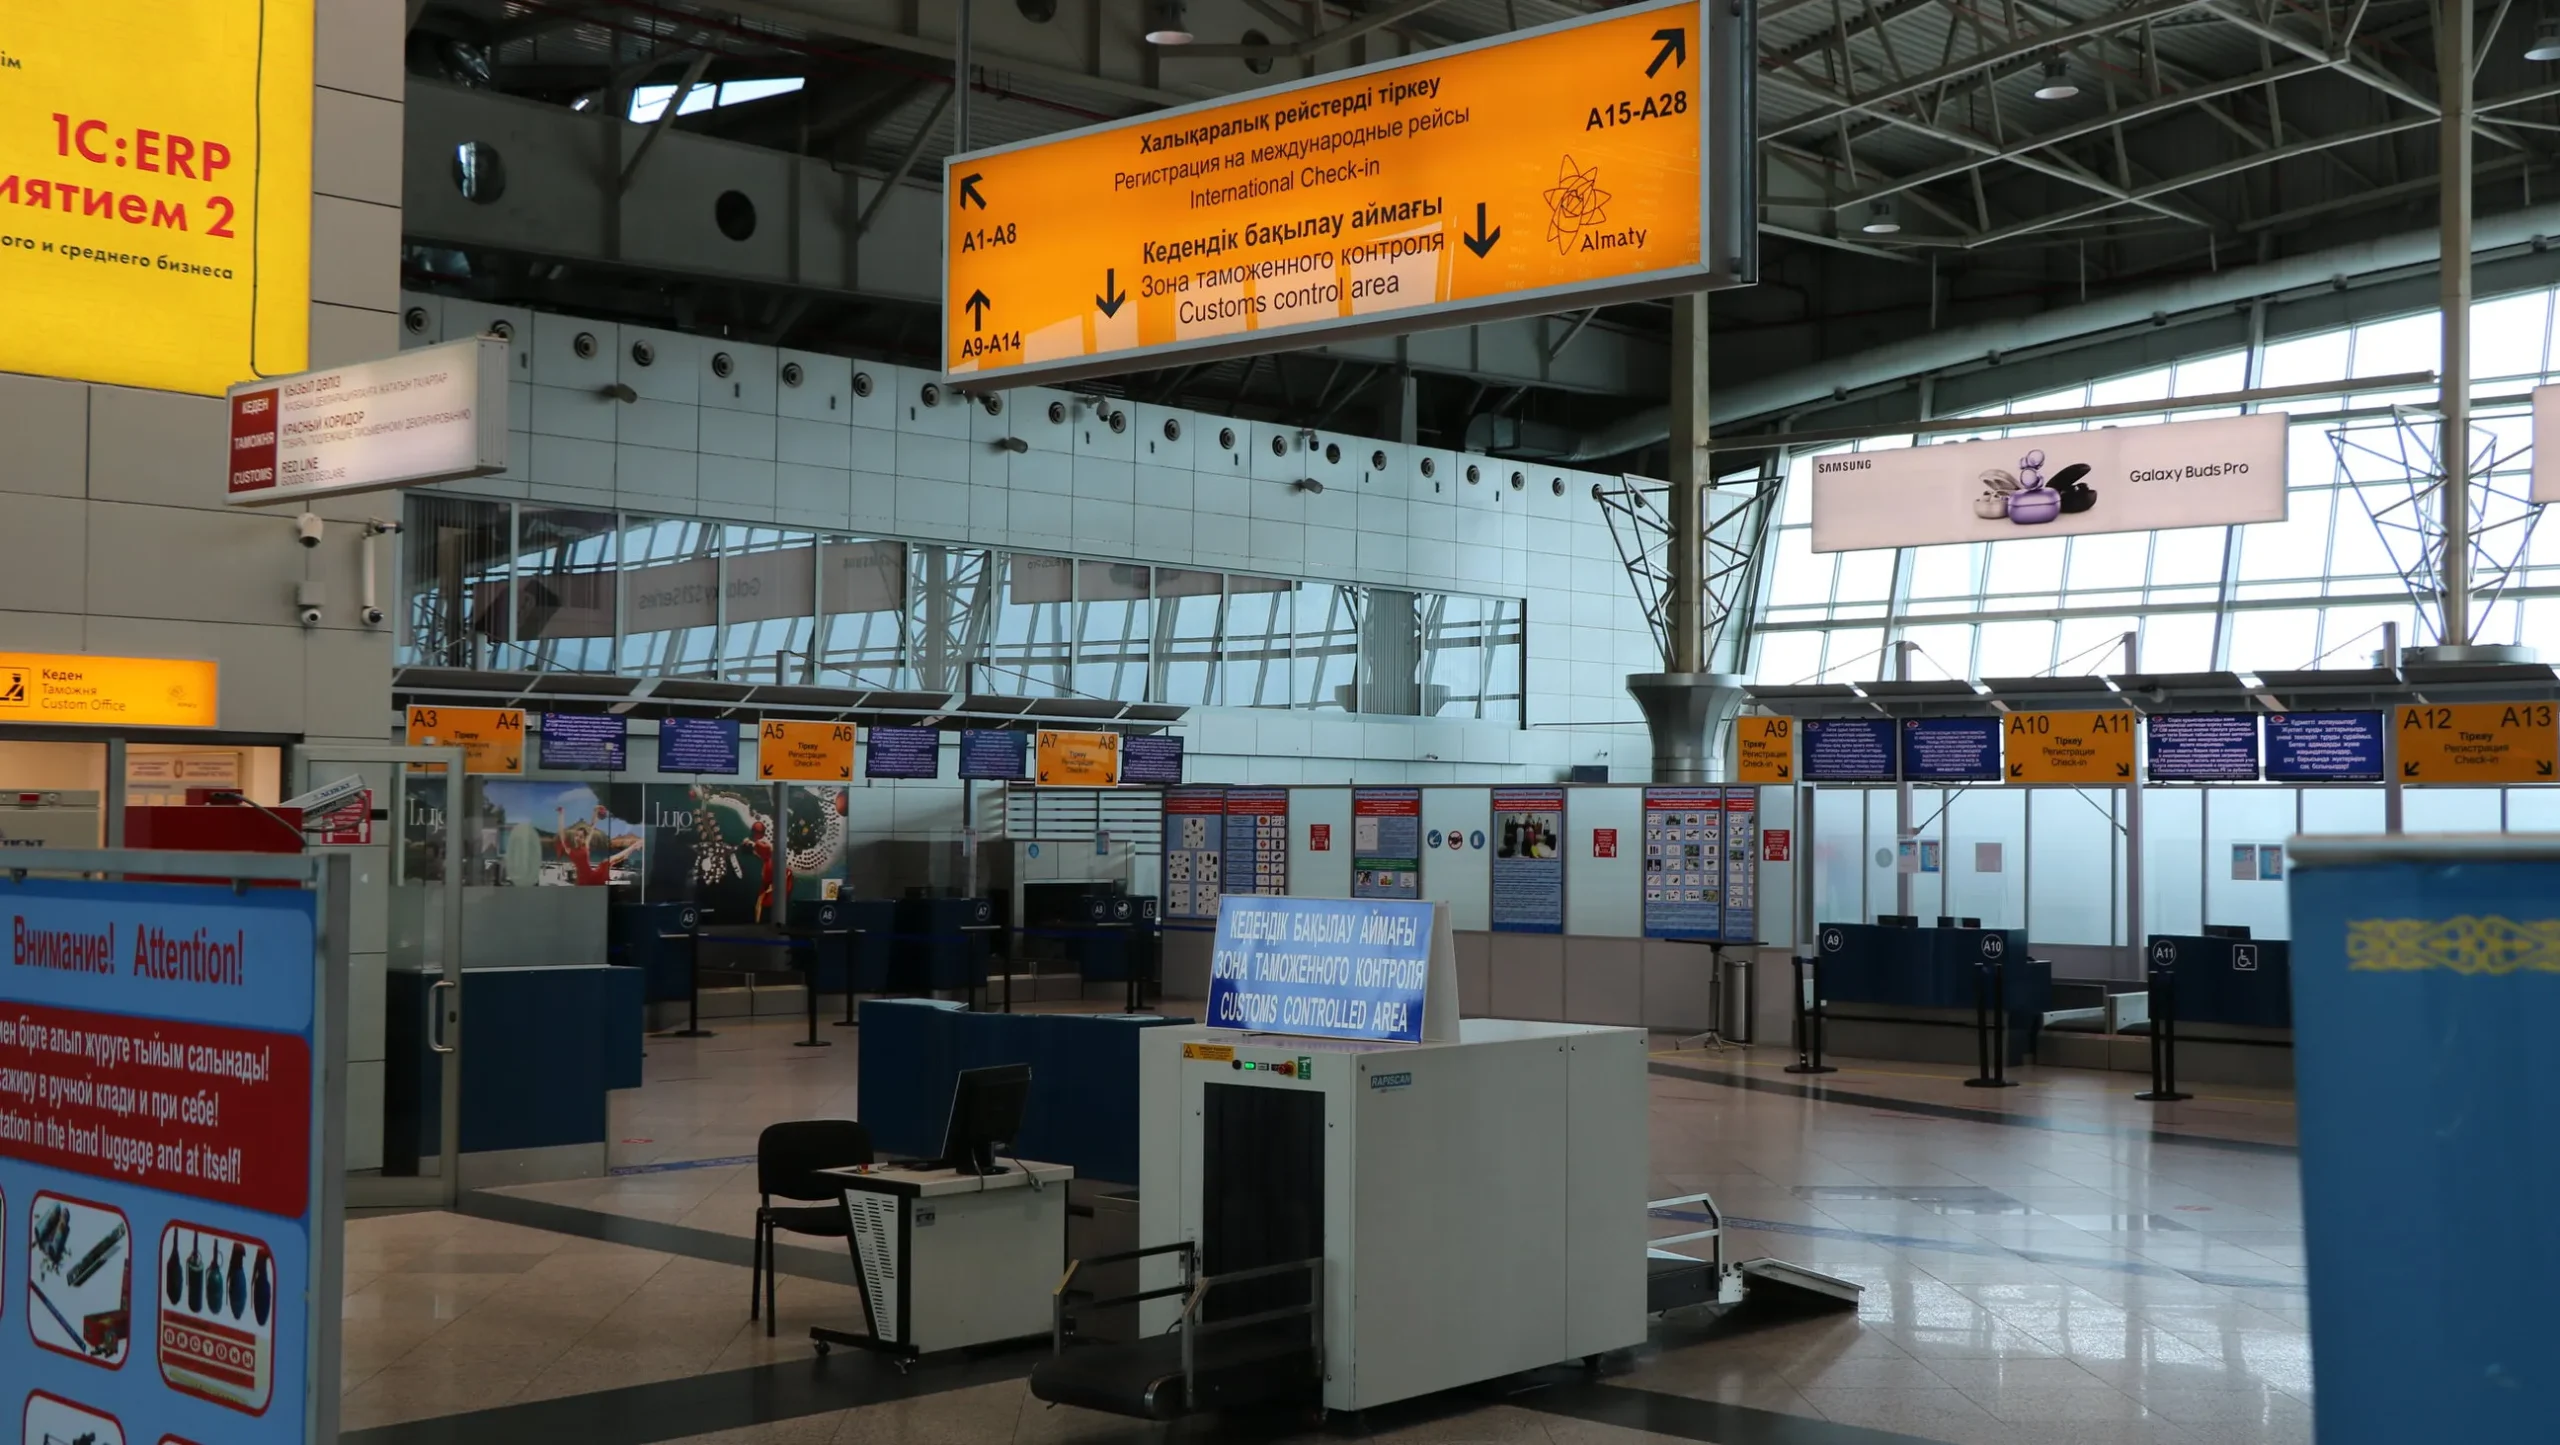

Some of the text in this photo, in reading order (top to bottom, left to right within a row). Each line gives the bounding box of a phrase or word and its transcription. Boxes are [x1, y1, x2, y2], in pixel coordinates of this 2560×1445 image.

[1140, 76, 1442, 154] Халықаралық рейстерді тіркеу
[1586, 90, 1687, 131] A15-A28
[1115, 107, 1471, 191] Регистрация на международные рейсы
[1190, 158, 1380, 209] International Check-in
[205, 195, 234, 239] 2
[962, 222, 1017, 253] A1-A8
[1143, 197, 1443, 264] Кедендік бақылау аймағы
[1581, 227, 1647, 252] Almaty
[41, 241, 54, 252] и
[60, 243, 150, 267] среднего
[157, 254, 233, 279] бизнеса
[1141, 232, 1445, 298] Зона таможенного контроля
[1180, 275, 1399, 324] Customs control area
[962, 331, 1021, 359] A9-A14
[323, 411, 364, 427] КОРИДОР
[234, 431, 275, 450] ТАМОЖНЯ
[282, 456, 318, 473] RED LINE
[1818, 459, 1871, 474] SAMSUNG
[2130, 460, 2250, 484] Galaxy Buds Pro
[233, 467, 273, 485] CUSTOMS
[42, 669, 82, 681] Кеден
[42, 683, 97, 695] Таможня
[41, 698, 126, 711] Custom Office
[412, 709, 520, 730] A3 A4
[2010, 714, 2129, 734] A10 A11
[2404, 705, 2552, 730] A12 A13
[764, 723, 852, 741] A5 A6
[1764, 720, 1788, 738] A9
[2458, 731, 2493, 742] Тіркеу
[1040, 733, 1115, 750] A7 A8
[2054, 736, 2082, 746] Тіркеу
[2444, 744, 2509, 753] Регистрация
[1742, 749, 1787, 759] Регистрация
[2043, 747, 2095, 757] Регистрация
[2454, 755, 2499, 764] Check-in
[1743, 759, 1773, 768] Check-in
[2051, 758, 2087, 766] Check-in
[656, 802, 692, 835] Lujo
[683, 913, 693, 922] A5
[822, 911, 832, 920] A6
[979, 907, 987, 916] A7
[1230, 908, 1417, 947] КЕДЕНДІК БАҚЫЛАУ АЙМАҒЫ
[13, 915, 114, 975] Внимание!
[1827, 935, 1839, 946] A9
[1983, 940, 2001, 951] A10
[133, 923, 244, 986] Attention!
[2156, 946, 2174, 958] A11
[1215, 950, 1424, 990] ЗОНА ТАМОЖЕННОГО КОНТРОЛЯ
[1220, 992, 1407, 1032] CUSTOMS CONTROLLED AREA
[20, 1014, 47, 1056] бірге
[50, 1027, 81, 1054] алып
[85, 1032, 130, 1070] жүруге
[133, 1031, 183, 1069] тыйым
[188, 1044, 269, 1085] салынады!
[1372, 1075, 1411, 1087] RAPISCAN
[40, 1074, 46, 1097] в
[50, 1072, 92, 1109] ручной
[96, 1084, 135, 1118] клади
[140, 1090, 148, 1115] и
[152, 1091, 177, 1127] при
[181, 1090, 219, 1128] себе!
[34, 1112, 44, 1145] in
[47, 1115, 65, 1150] the
[69, 1119, 98, 1157] hand
[102, 1125, 153, 1174] luggage
[157, 1138, 182, 1174] and
[186, 1144, 199, 1177] at
[203, 1143, 241, 1184] itself!
[164, 1328, 253, 1368] ПИСТОНЫ
